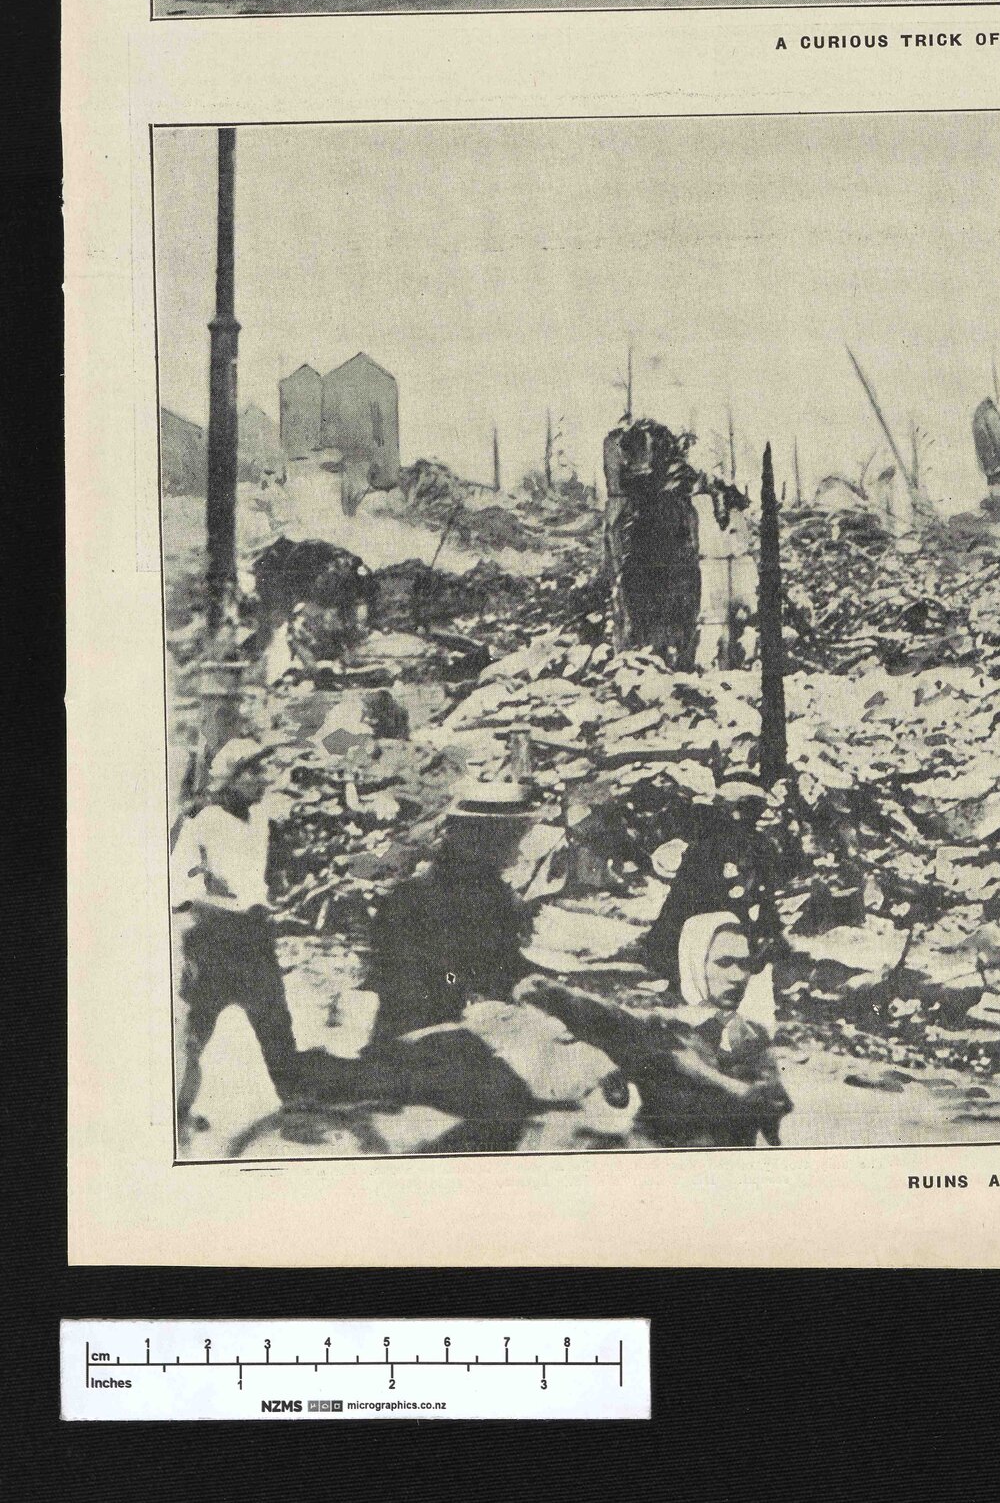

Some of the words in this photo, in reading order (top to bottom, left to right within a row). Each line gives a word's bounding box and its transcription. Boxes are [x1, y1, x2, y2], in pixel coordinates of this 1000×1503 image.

[776, 37, 787, 50] A
[800, 35, 889, 49] CURIOUS
[901, 34, 963, 48] TRICK
[975, 32, 1000, 46] OF
[908, 1175, 969, 1189] RUINS
[91, 1352, 111, 1362] cm
[145, 1338, 151, 1348] 1
[204, 1339, 212, 1349] 2
[264, 1339, 272, 1349] 3
[324, 1337, 332, 1347] 4
[383, 1337, 391, 1347] 5
[444, 1337, 451, 1347] 6
[503, 1337, 511, 1347] 7
[563, 1337, 571, 1347] 8
[91, 1378, 132, 1389] Inches
[237, 1380, 243, 1390] 1
[389, 1379, 396, 1390] 2
[540, 1379, 548, 1390] 3
[261, 1400, 303, 1413] NZMS
[347, 1400, 447, 1412] micrographics.co.nz
